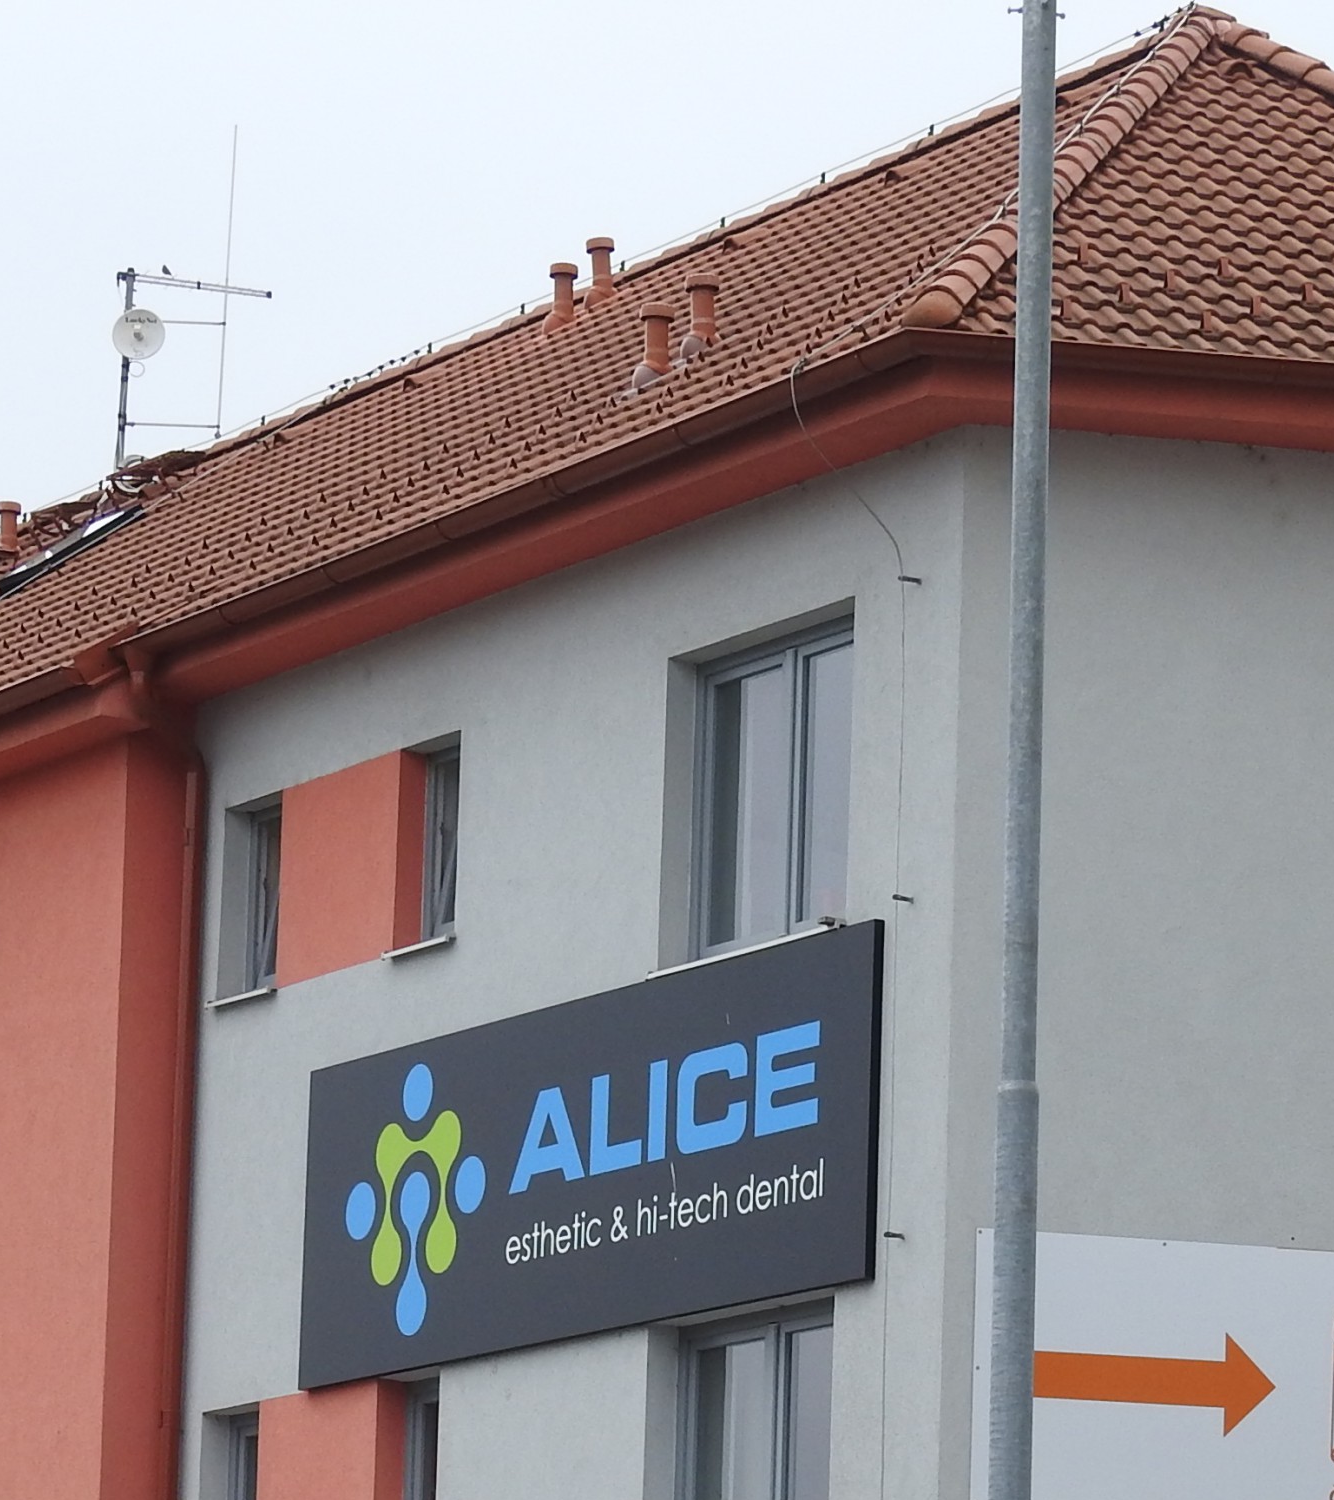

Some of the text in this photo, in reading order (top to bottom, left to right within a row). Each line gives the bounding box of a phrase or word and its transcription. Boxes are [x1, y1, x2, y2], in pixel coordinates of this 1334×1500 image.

[508, 1020, 821, 1195] ALICE
[504, 1158, 825, 1265] esthetic & hi-tech dental
